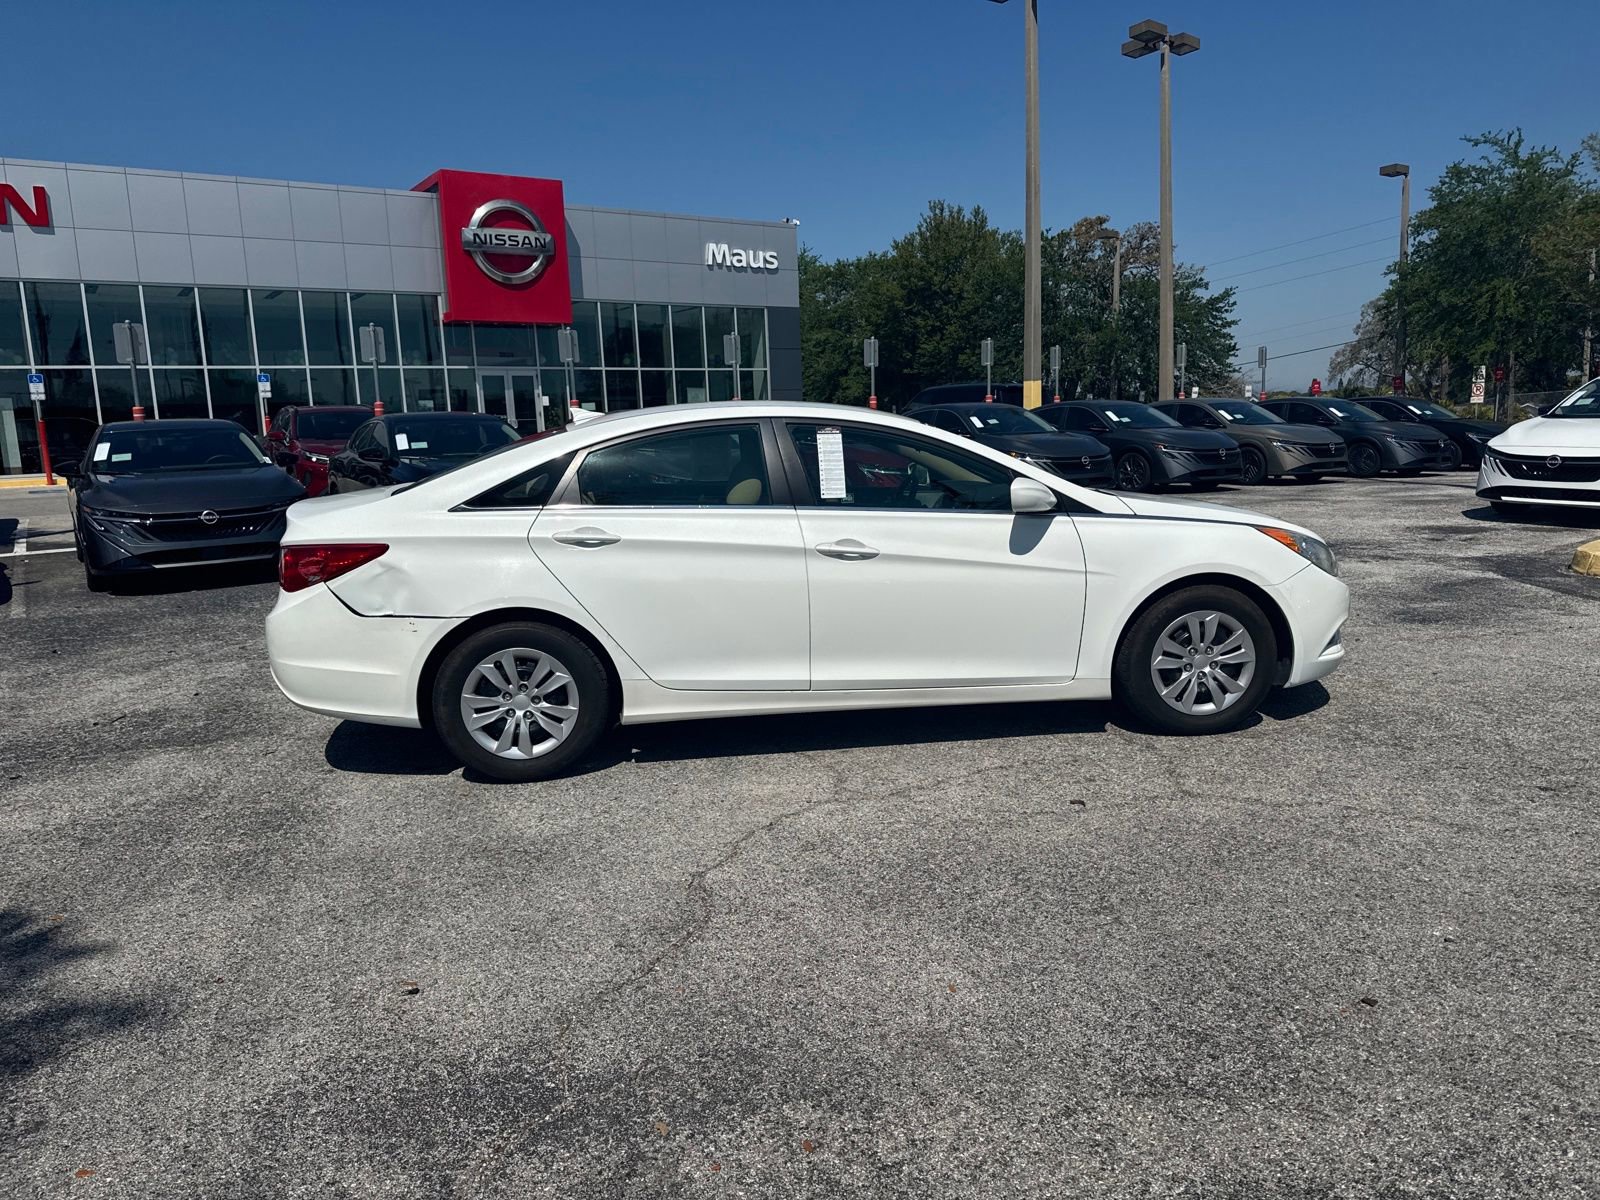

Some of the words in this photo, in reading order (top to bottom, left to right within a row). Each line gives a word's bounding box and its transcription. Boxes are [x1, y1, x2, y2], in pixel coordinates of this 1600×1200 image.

[0, 184, 49, 228] N
[472, 232, 547, 249] NISSAN
[705, 242, 779, 270] Maus
